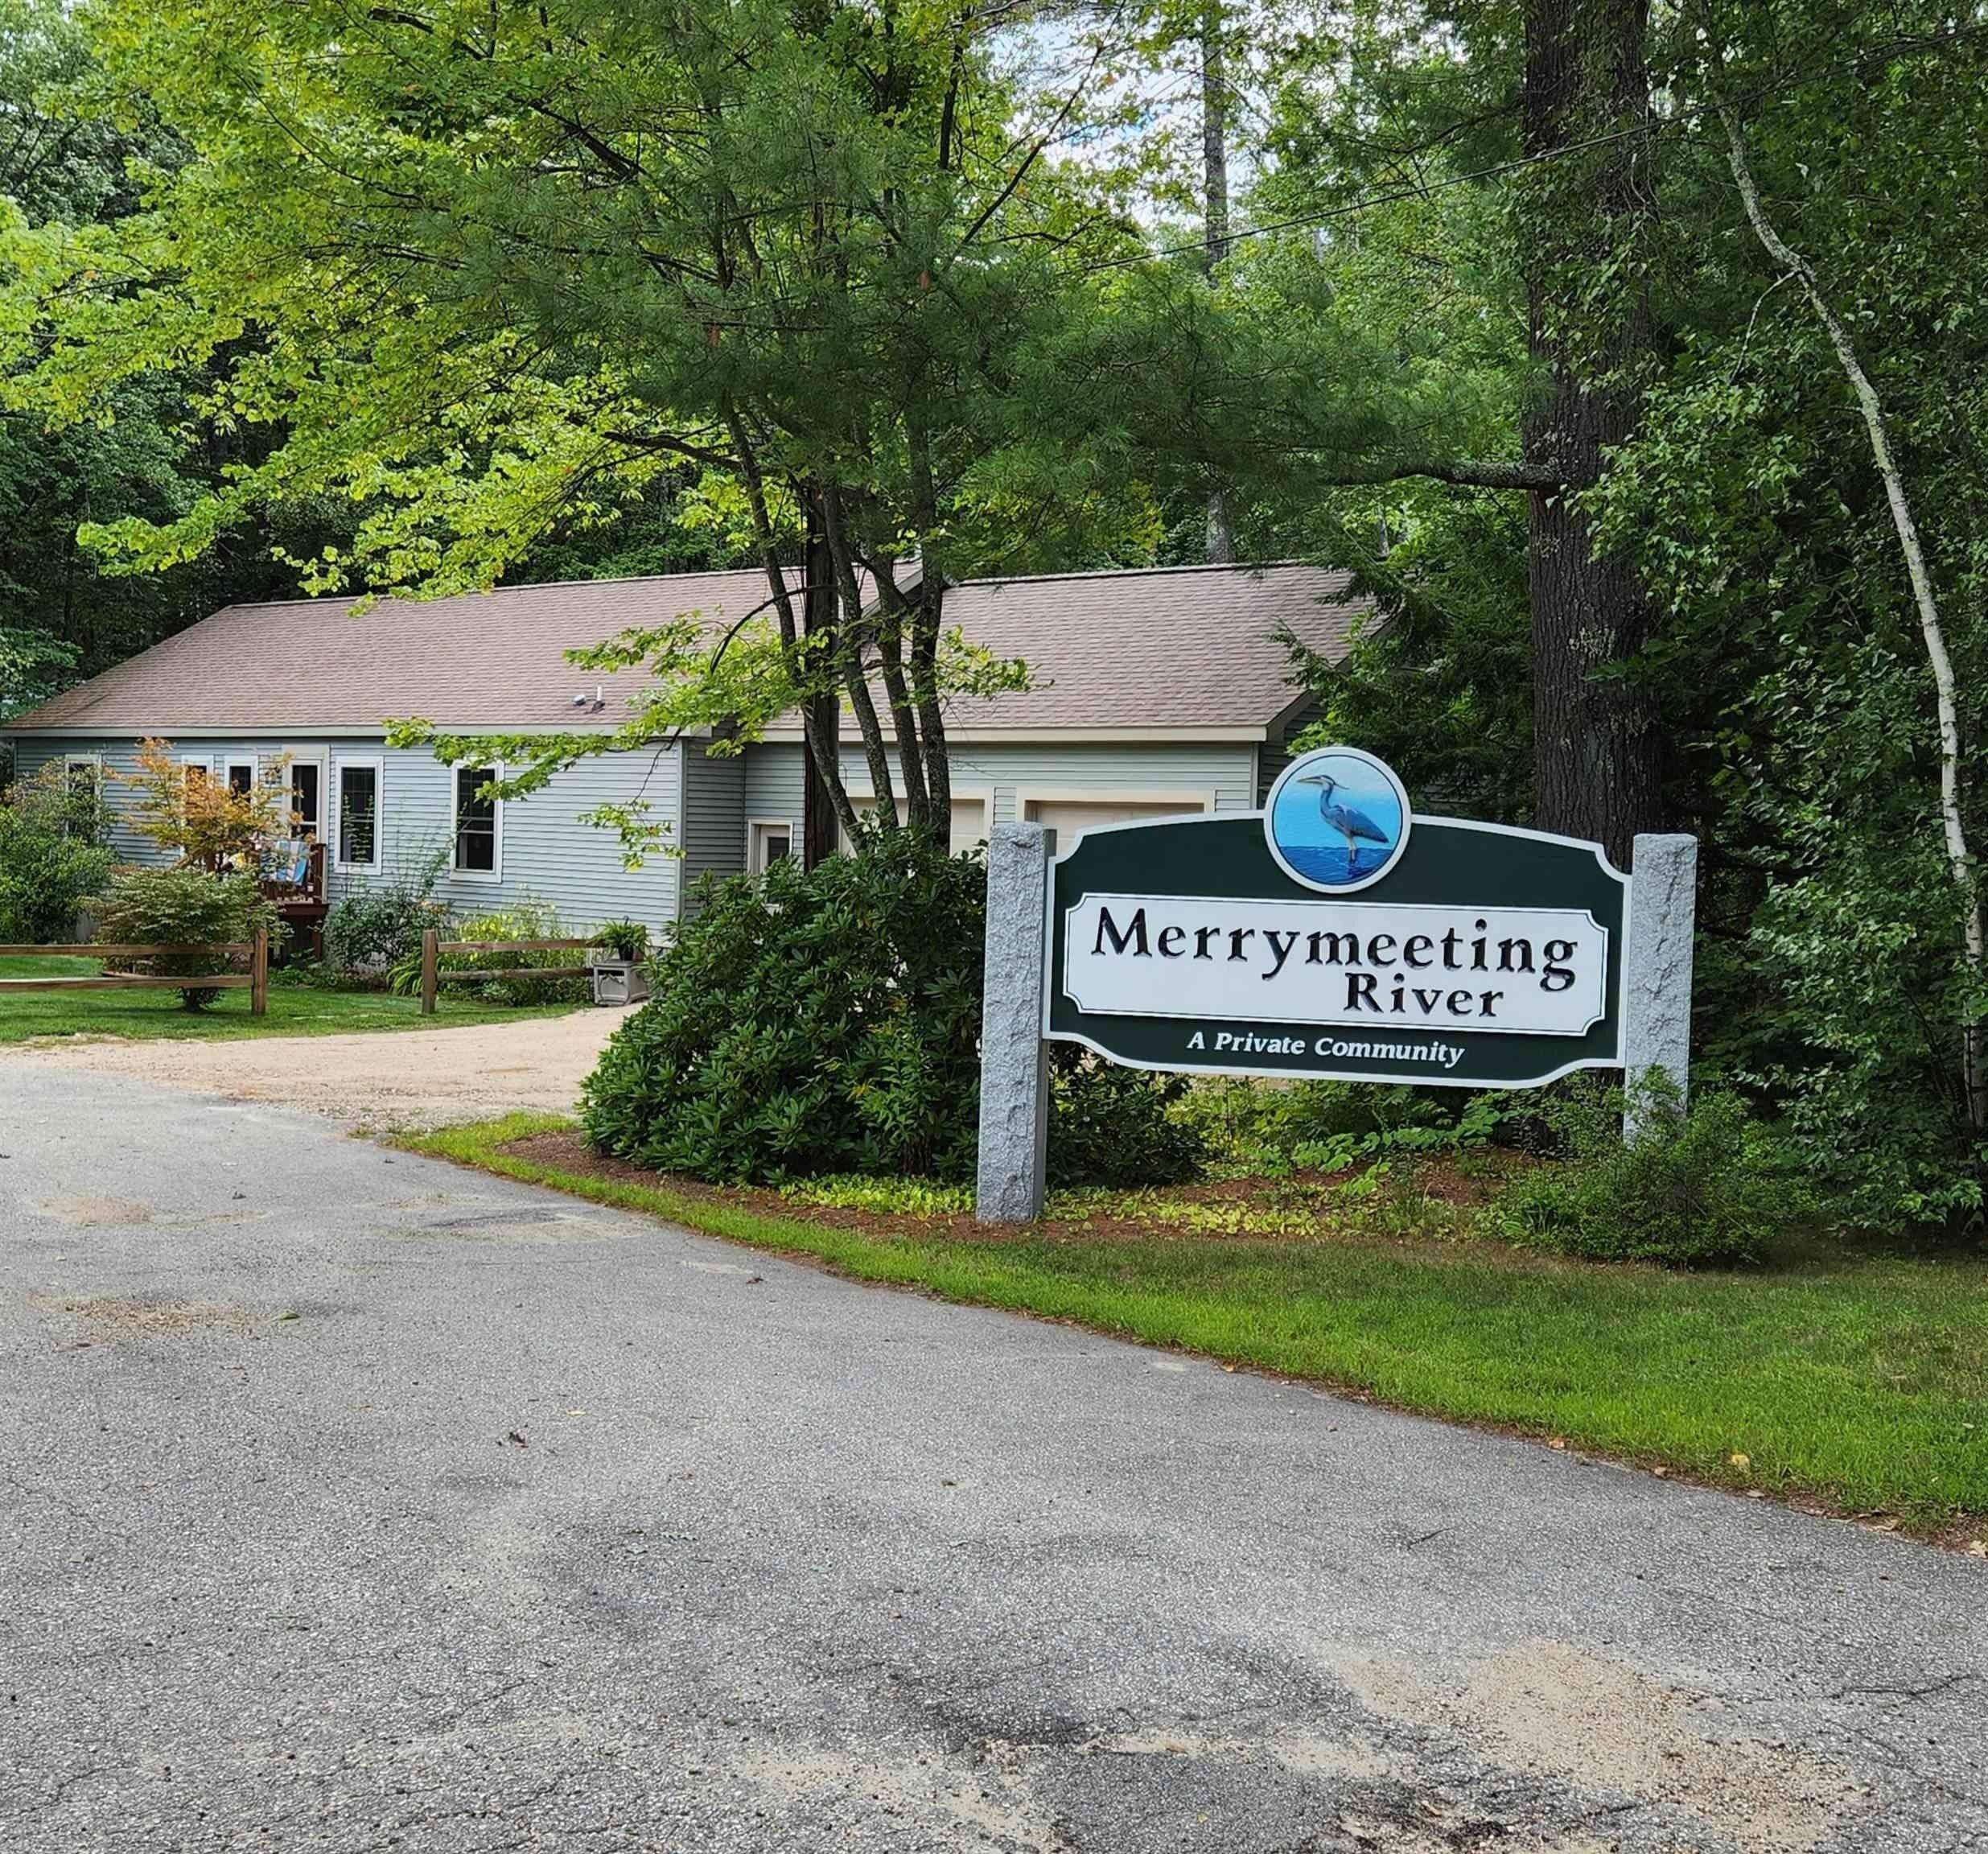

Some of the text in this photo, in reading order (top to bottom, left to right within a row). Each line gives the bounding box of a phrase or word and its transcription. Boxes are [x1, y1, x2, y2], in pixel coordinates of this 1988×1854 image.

[1091, 907, 1578, 992] Merrymeeting
[1344, 972, 1504, 1019] River
[1187, 1032, 1464, 1069] A Private Community
